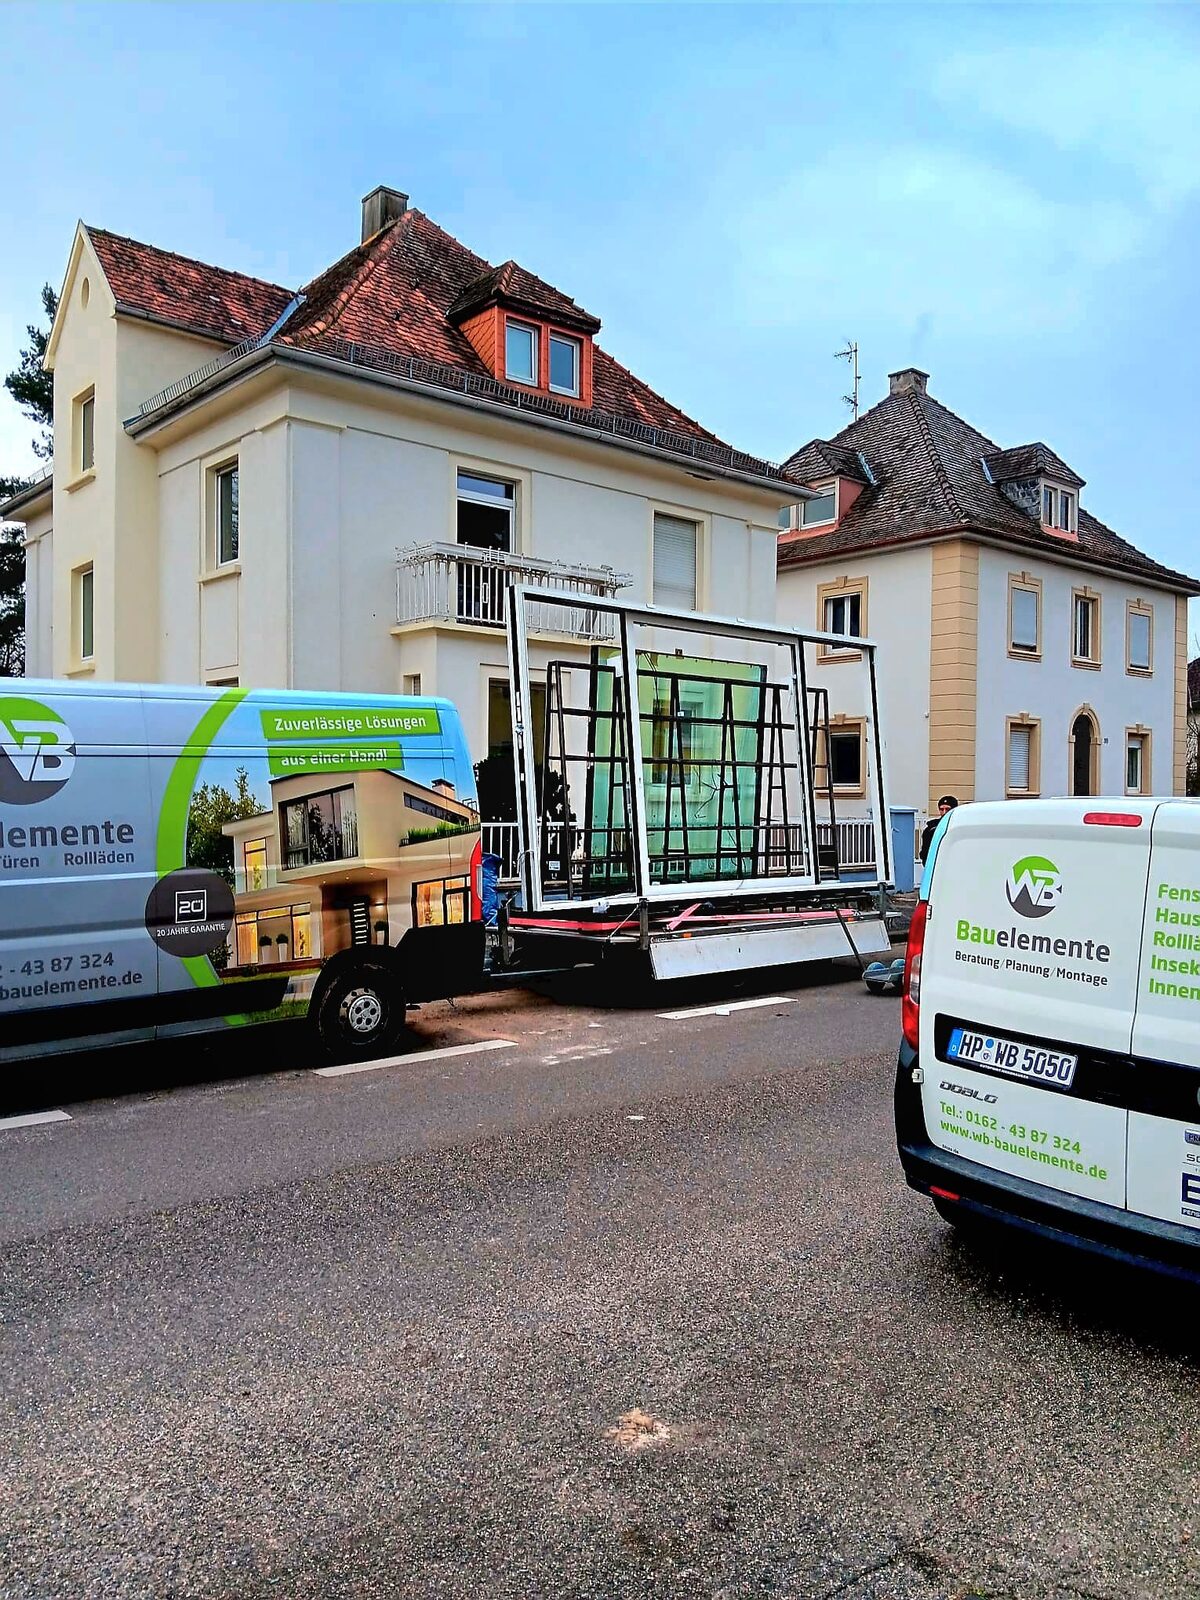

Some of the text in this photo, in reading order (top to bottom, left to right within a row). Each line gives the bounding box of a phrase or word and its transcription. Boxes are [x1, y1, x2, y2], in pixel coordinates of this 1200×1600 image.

[274, 715, 427, 732] Zuverlässige Lösungen
[281, 749, 388, 766] aus einer Hand!
[0, 850, 134, 869] üren Rollläden
[1158, 883, 1200, 902] Fens
[1155, 907, 1200, 927] Haus
[157, 922, 226, 937] 20 JAHRE GARANTIE
[956, 919, 1111, 963] Bauelemente
[20, 960, 45, 976] 43
[51, 957, 73, 972] 87
[80, 952, 114, 969] 324
[1151, 954, 1200, 976] Insek
[1149, 978, 1200, 1000] Innen
[959, 1033, 984, 1058] HP
[994, 1042, 1020, 1068] WB
[1021, 1048, 1072, 1081] 5050
[940, 1101, 963, 1120] Tel.:
[966, 1110, 997, 1131] 0162
[1009, 1124, 1026, 1139] 43
[1030, 1129, 1048, 1145] 87
[1053, 1135, 1081, 1155] 324
[939, 1119, 1108, 1181] www.wb-bauelemente.de
